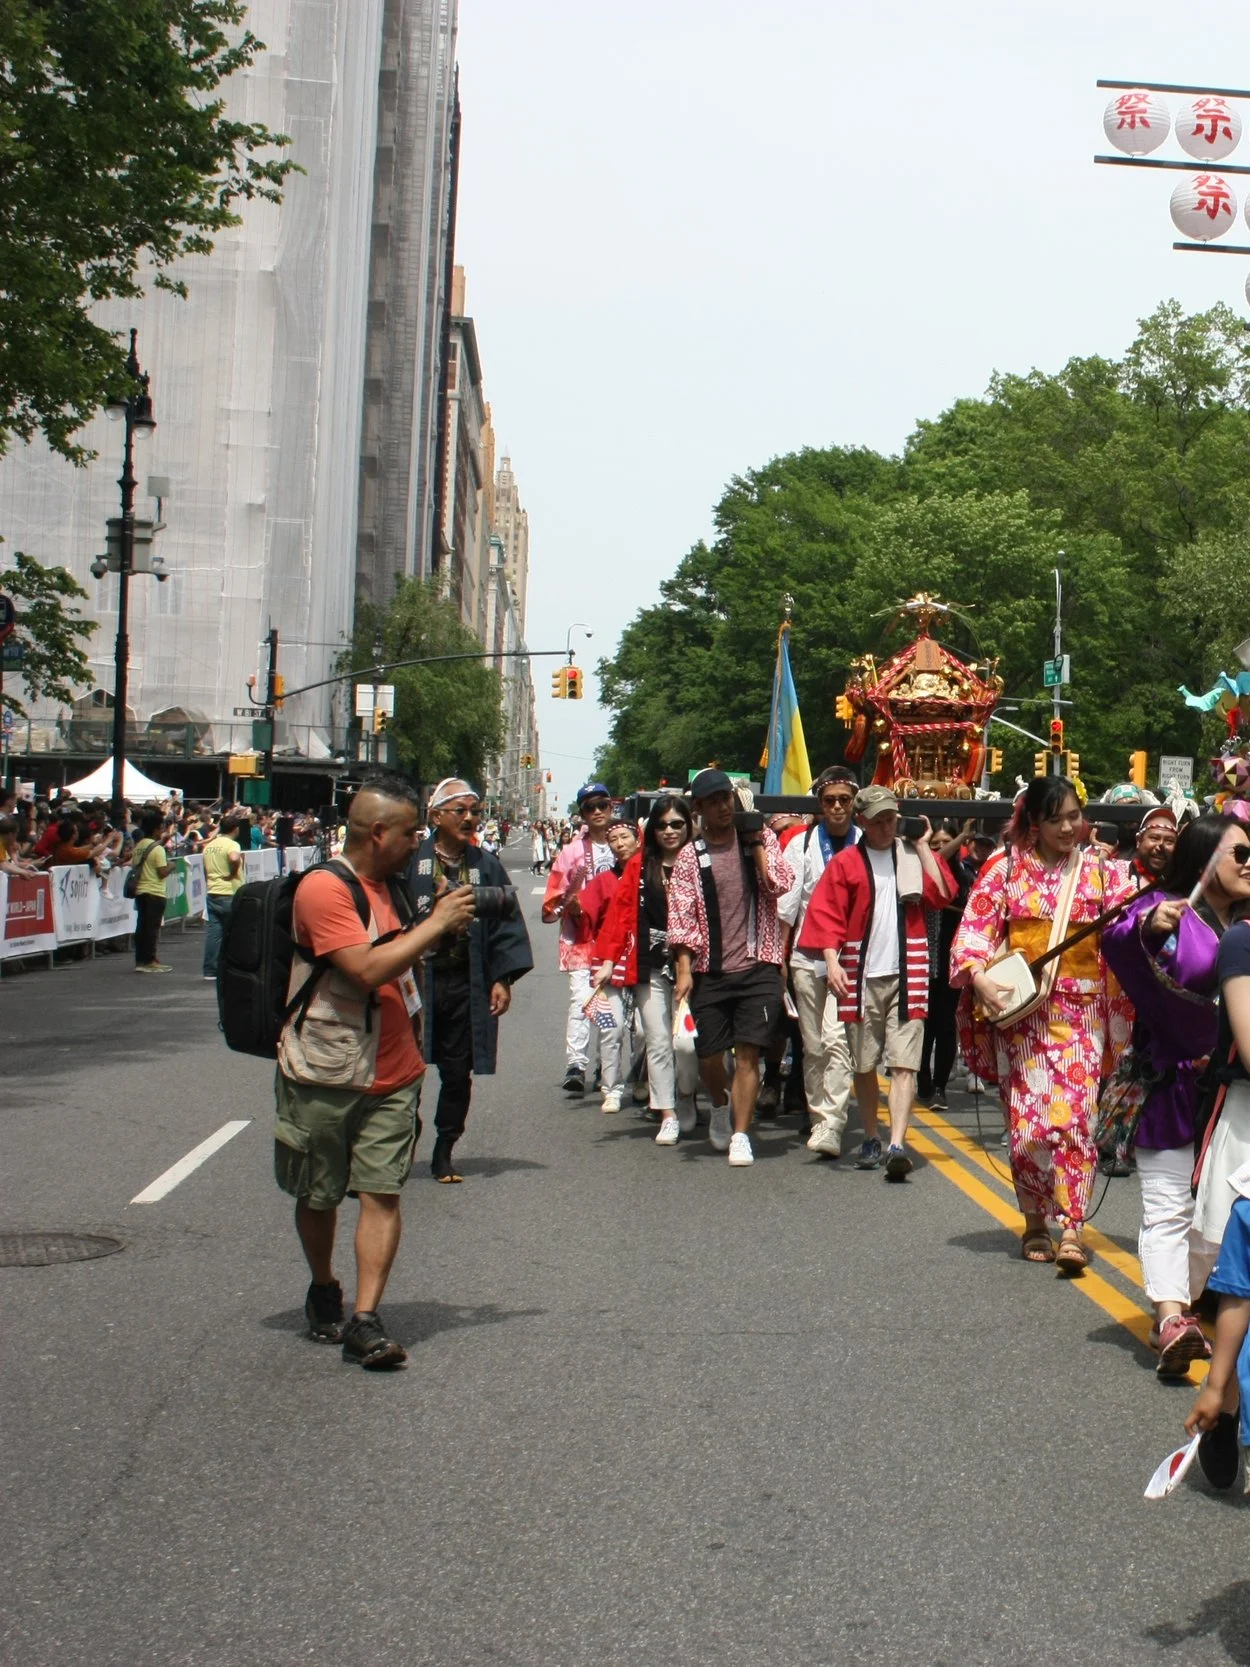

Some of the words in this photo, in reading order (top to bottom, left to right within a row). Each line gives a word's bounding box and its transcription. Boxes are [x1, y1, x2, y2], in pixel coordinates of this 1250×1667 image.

[1117, 91, 1150, 129] 祭
[1192, 97, 1232, 143] 祭
[1194, 174, 1232, 220] 祭
[205, 846, 223, 855] STAFF
